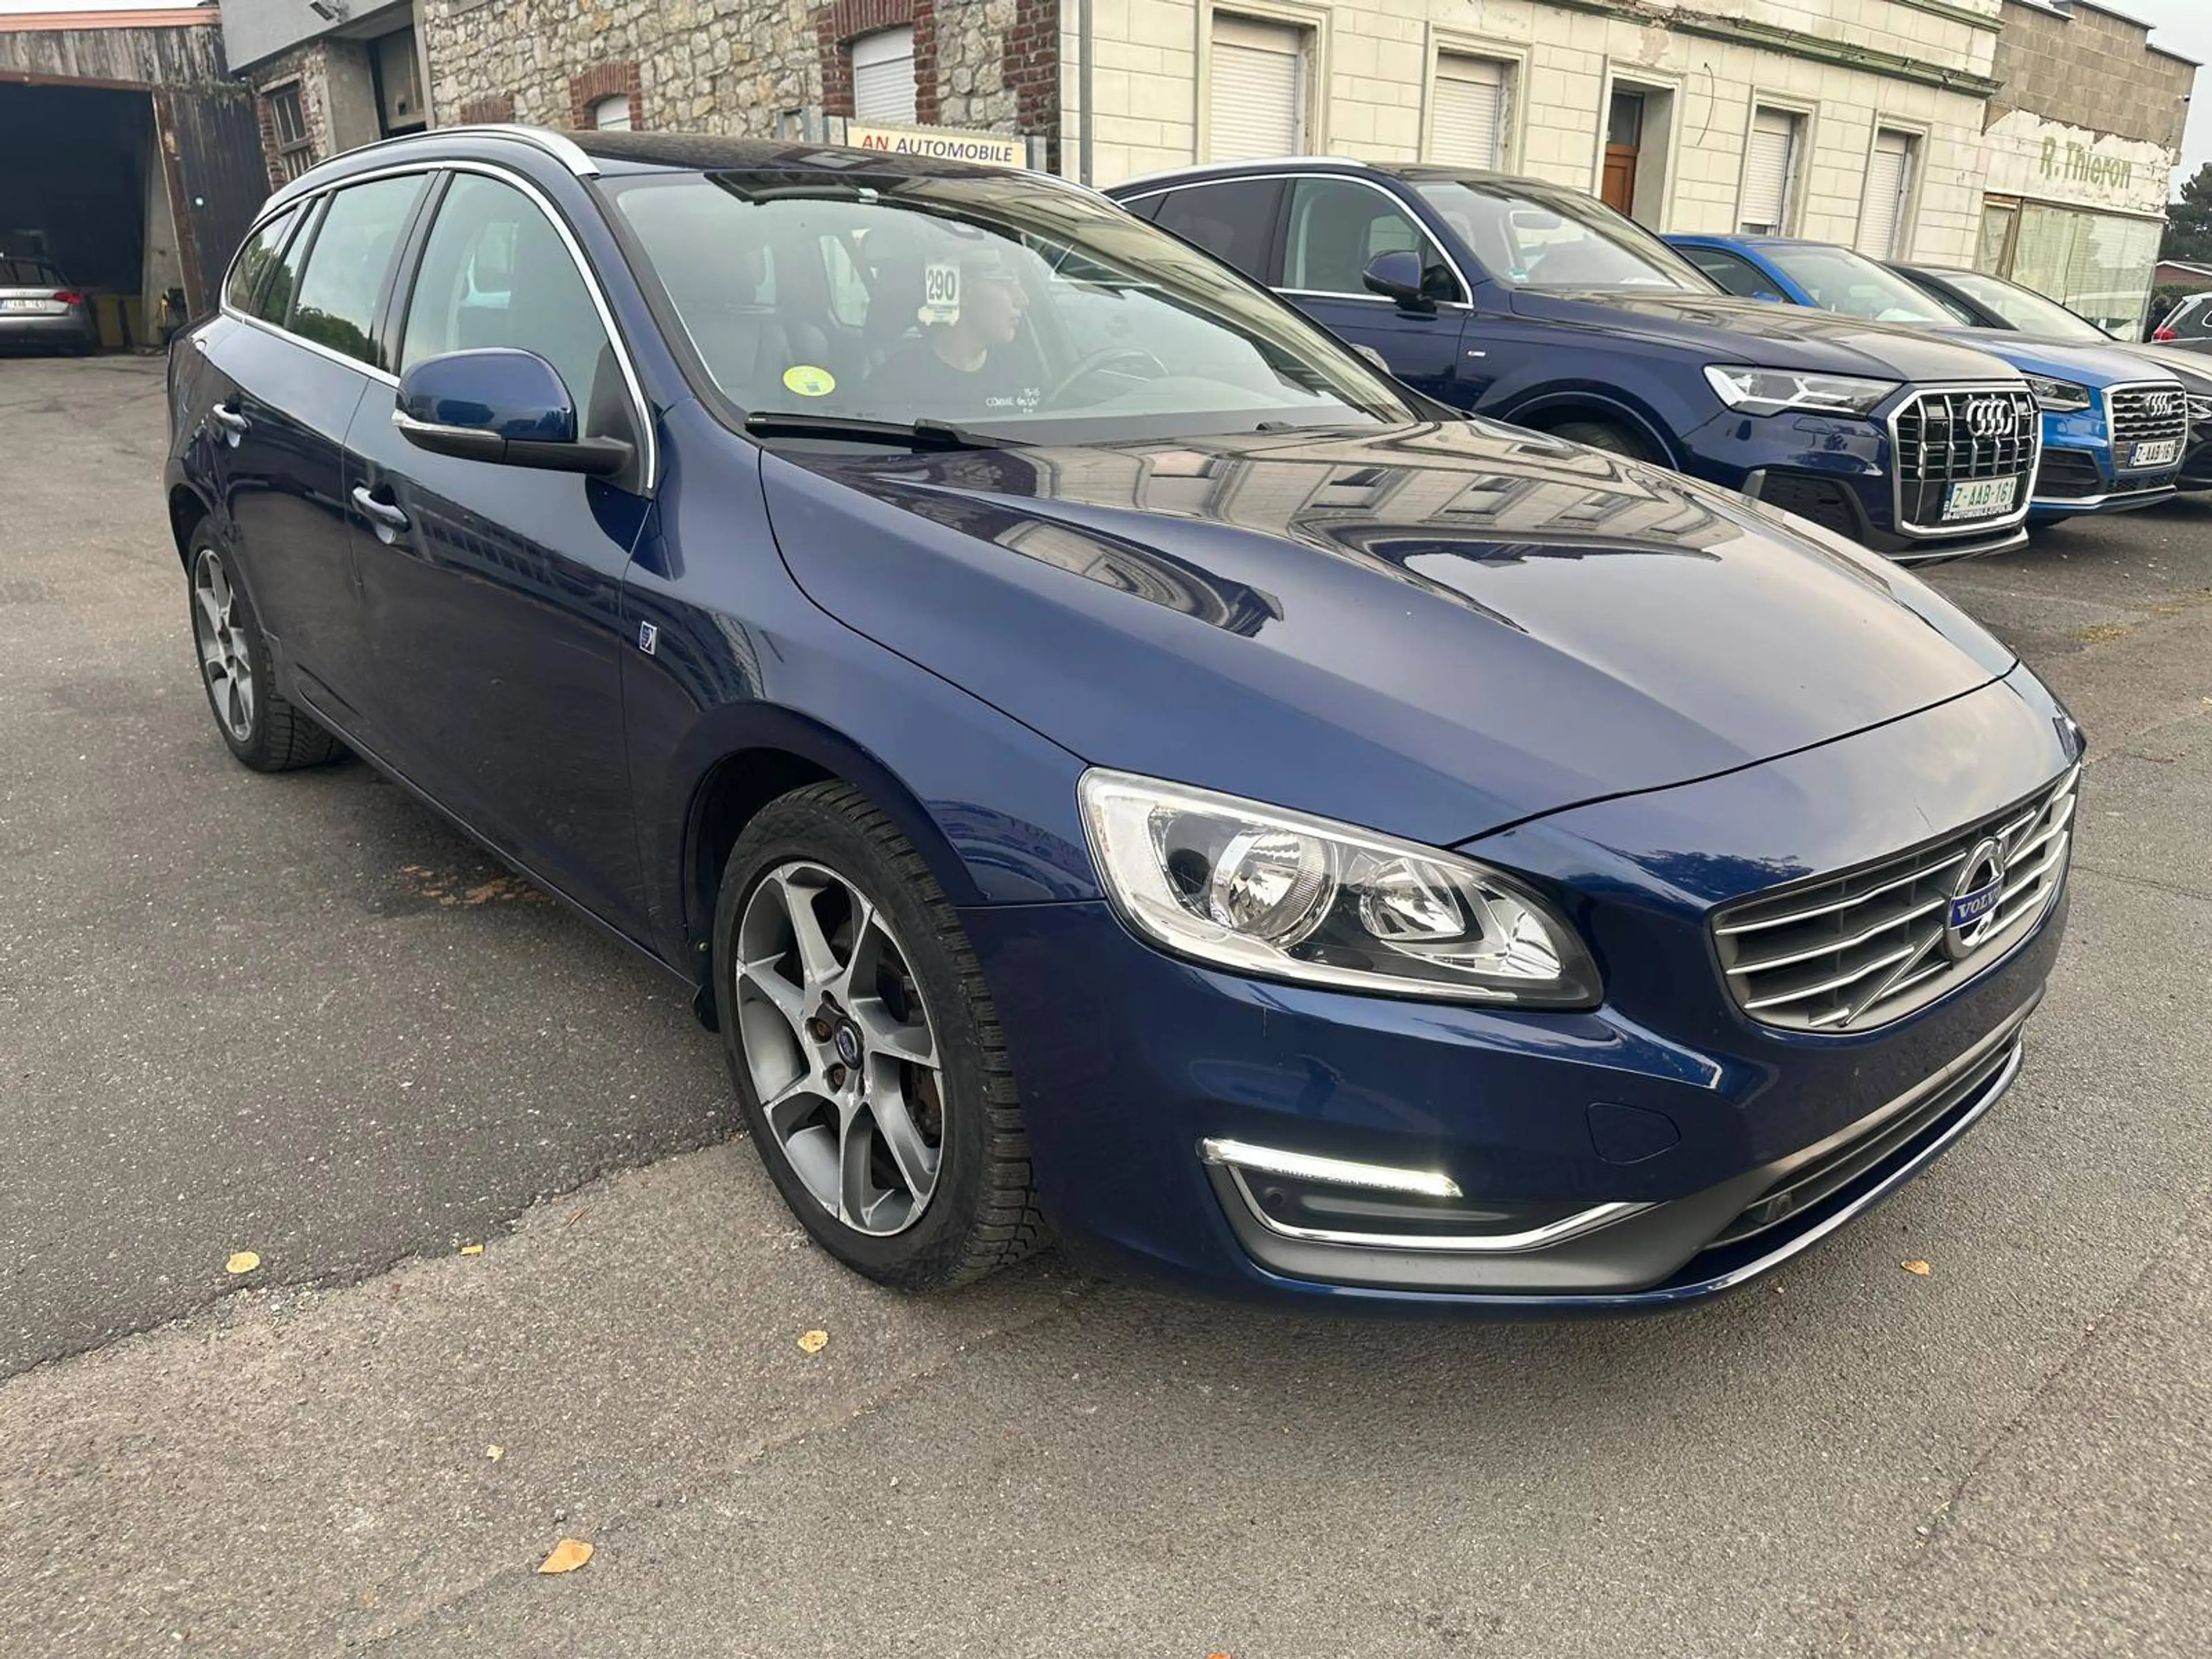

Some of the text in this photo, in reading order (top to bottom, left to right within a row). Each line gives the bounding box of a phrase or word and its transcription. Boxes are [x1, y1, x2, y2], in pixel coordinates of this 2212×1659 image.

[862, 134, 1013, 162] AN AUTOMOBILE
[2039, 136, 2059, 179] R.
[927, 269, 956, 301] 290
[1952, 480, 2014, 508] Z-AAB-161
[1959, 884, 2001, 917] VOLVO
